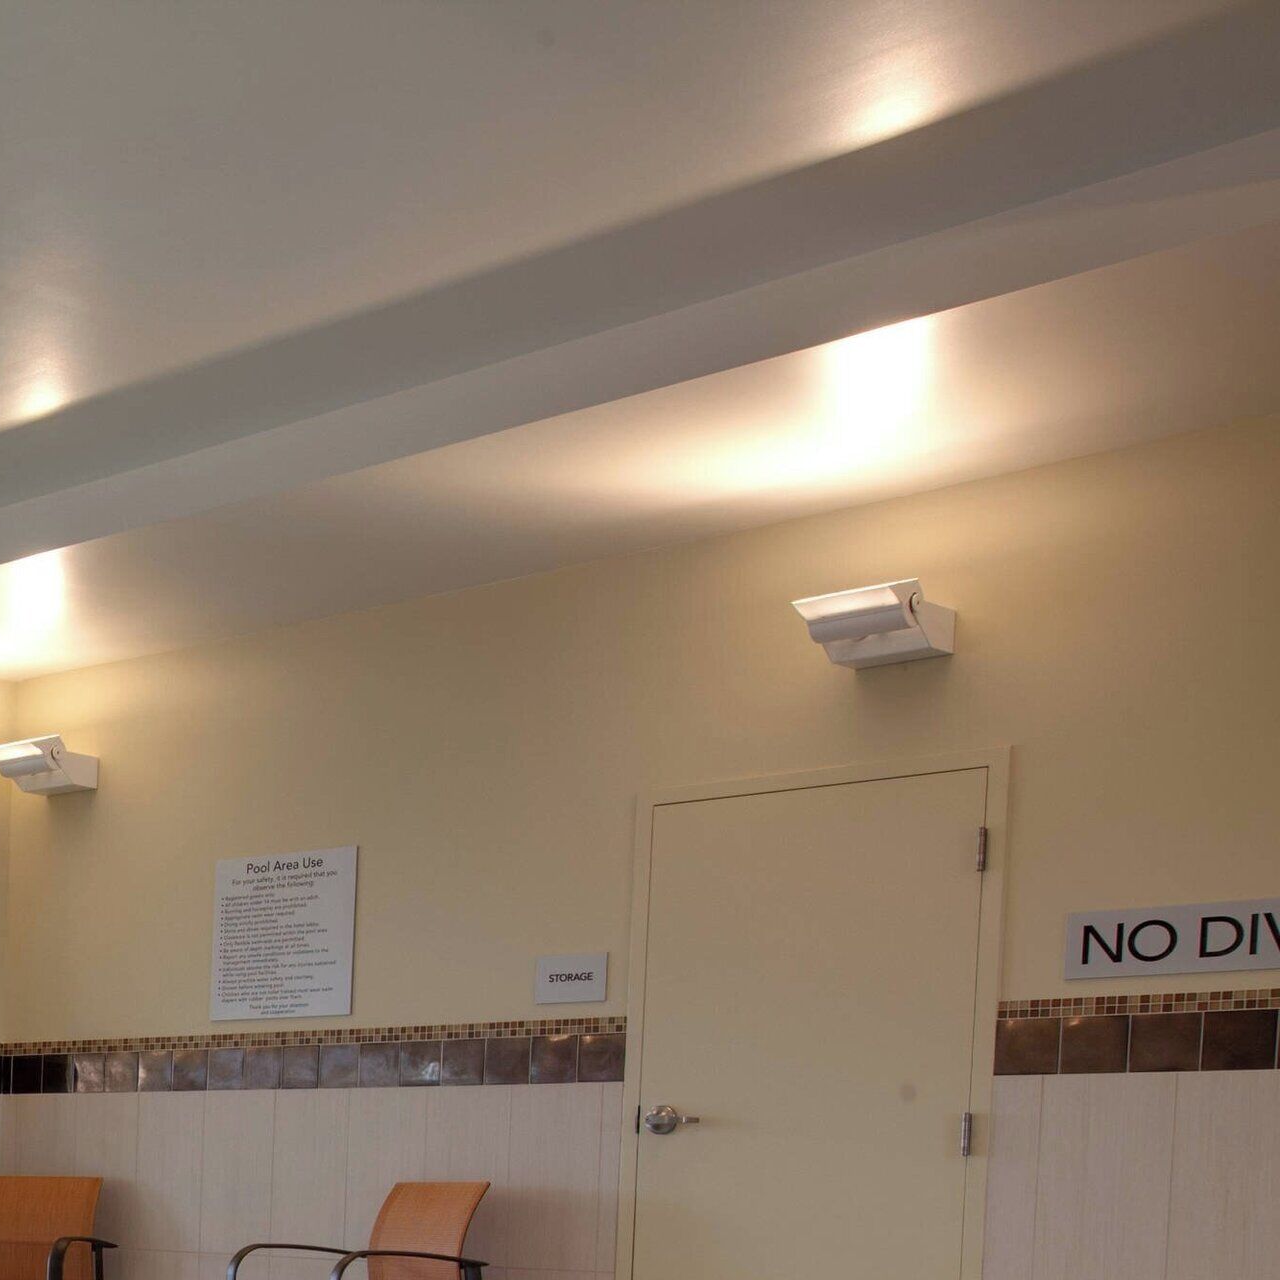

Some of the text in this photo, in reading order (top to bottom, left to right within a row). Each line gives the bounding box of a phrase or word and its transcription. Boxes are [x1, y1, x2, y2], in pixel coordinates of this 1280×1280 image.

[246, 857, 323, 874] Pool Area Use
[1081, 919, 1178, 964] NO
[548, 972, 594, 983] STORAGE
